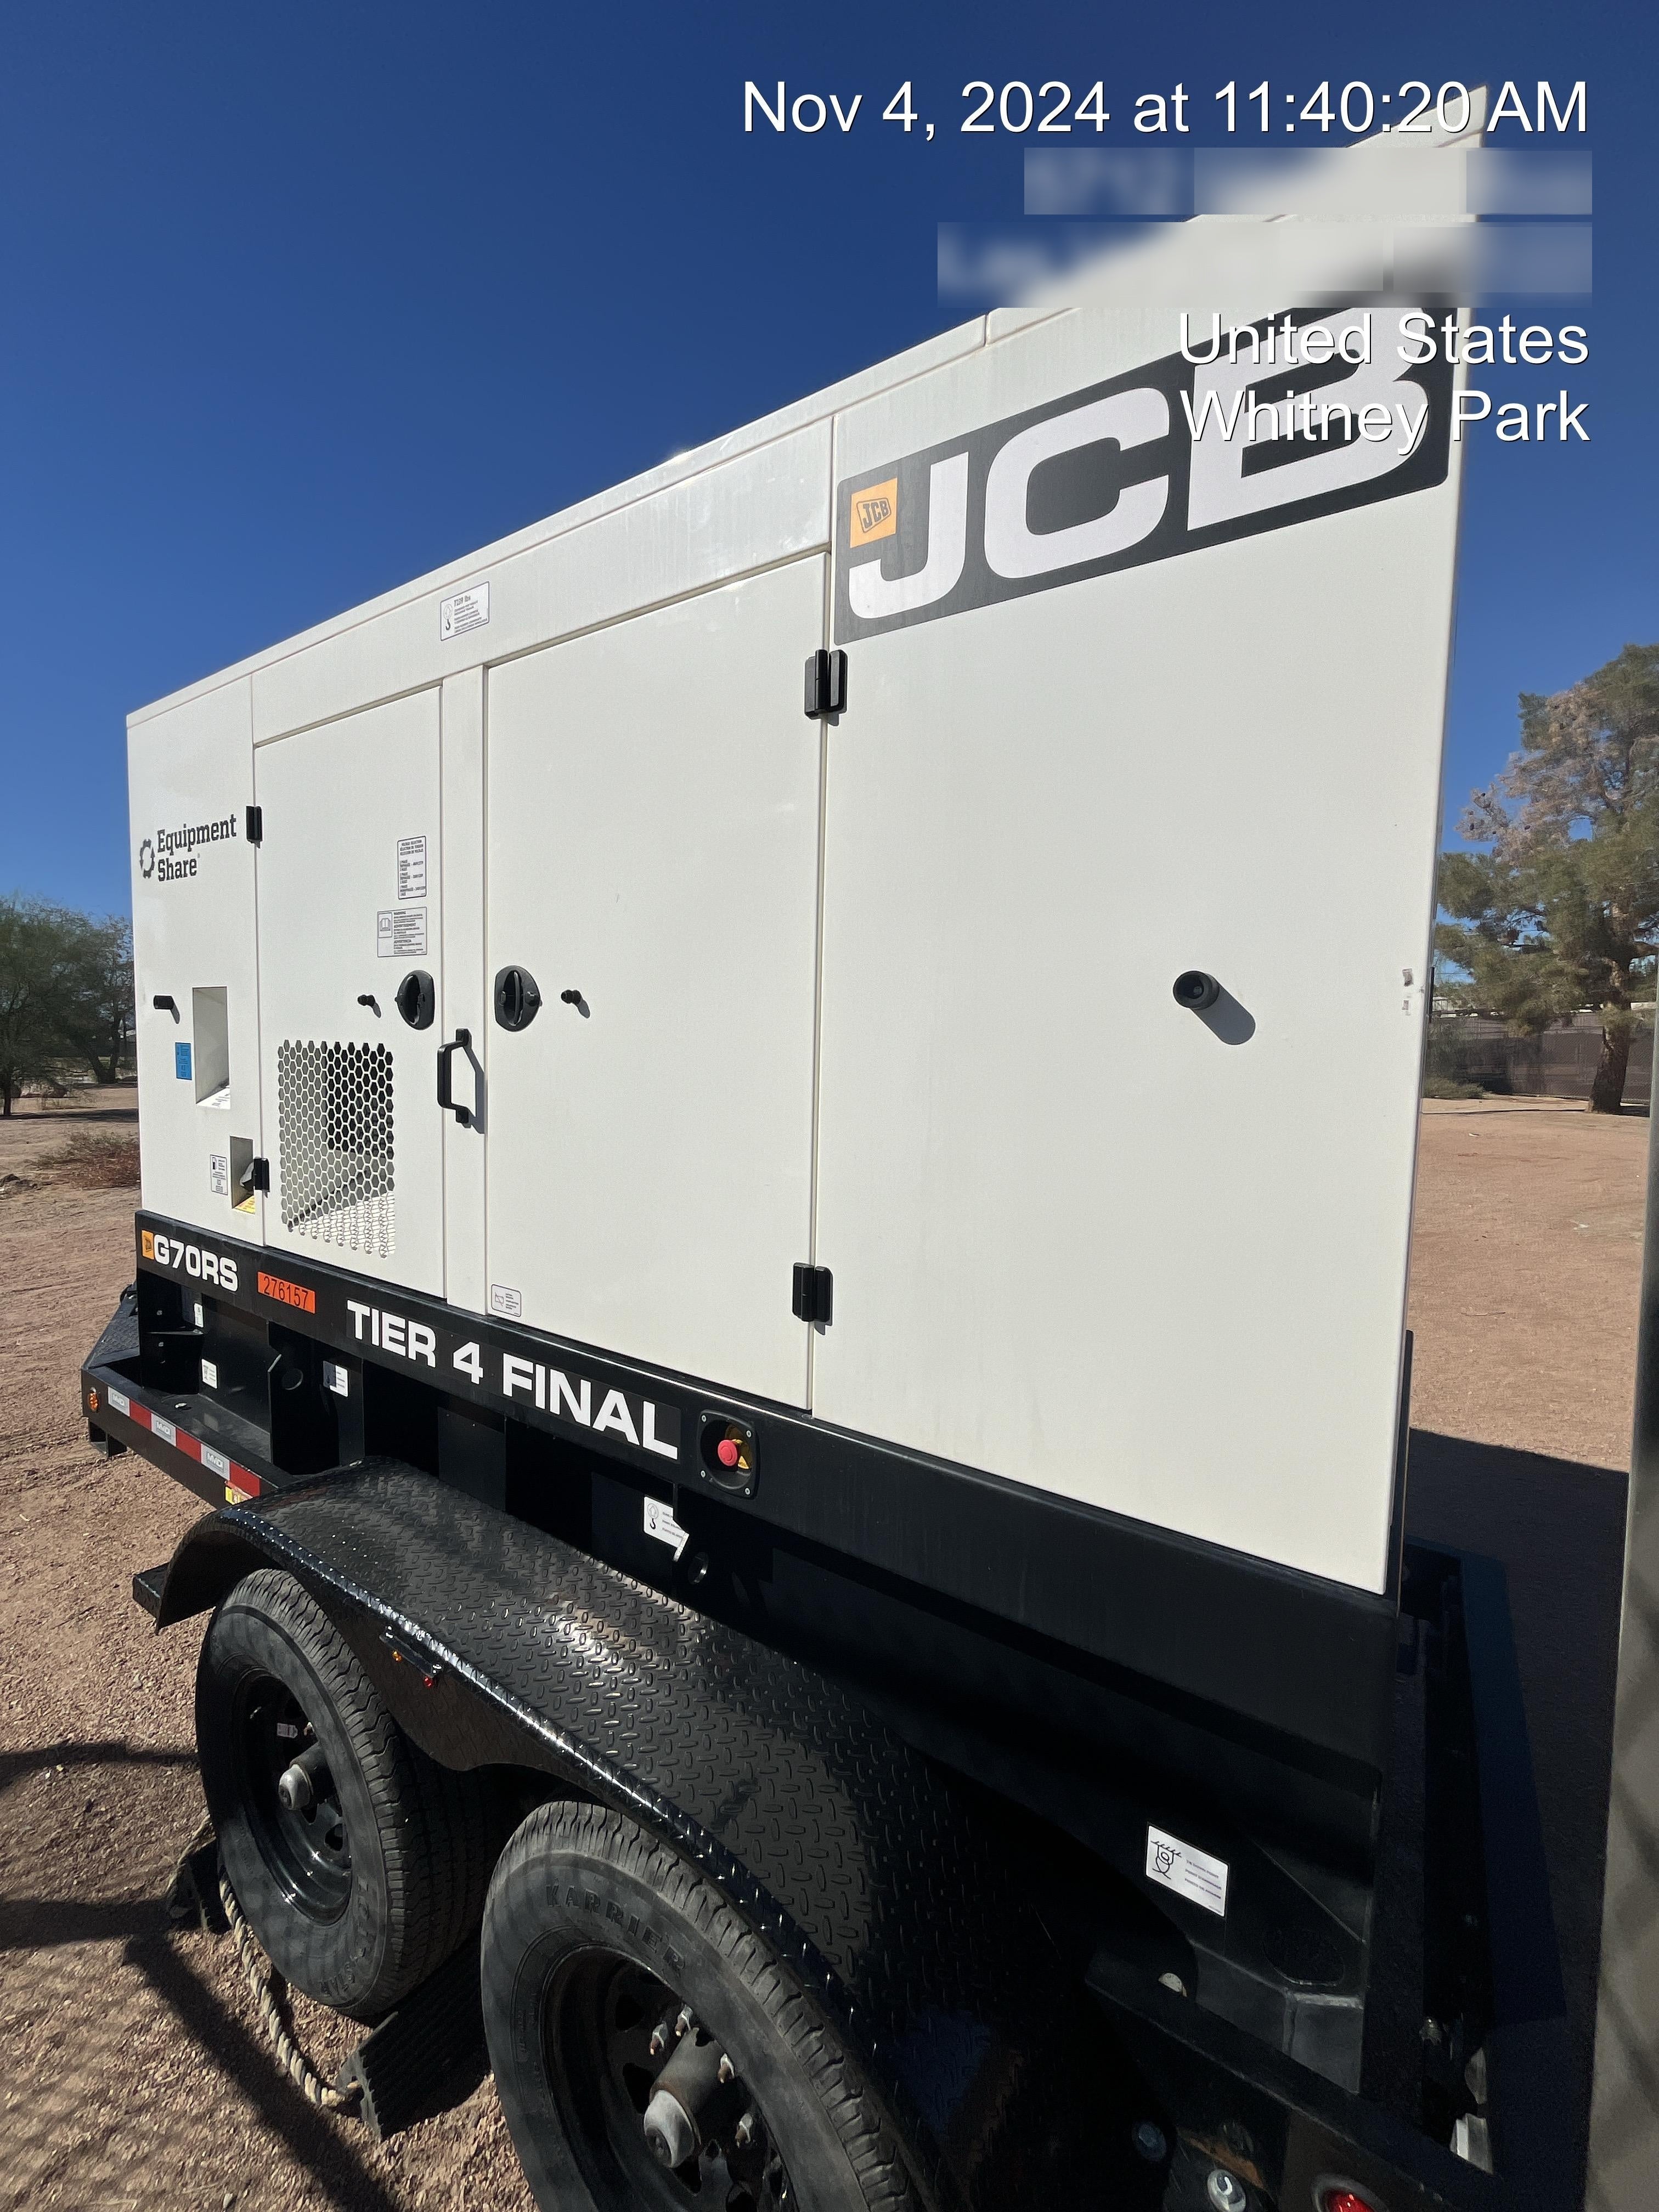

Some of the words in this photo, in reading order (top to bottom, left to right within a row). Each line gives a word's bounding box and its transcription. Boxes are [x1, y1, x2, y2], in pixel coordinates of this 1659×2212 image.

[848, 303, 1429, 620] JCB
[862, 500, 889, 529] JCB
[157, 814, 237, 856] Equipment
[157, 857, 198, 882] Share
[154, 1234, 238, 1292] G70RS
[263, 1276, 309, 1309] 276157
[346, 1299, 437, 1368] TIER
[453, 1341, 483, 1385] 4
[503, 1353, 678, 1460] FINAL
[545, 1884, 686, 1978] KARRIER
